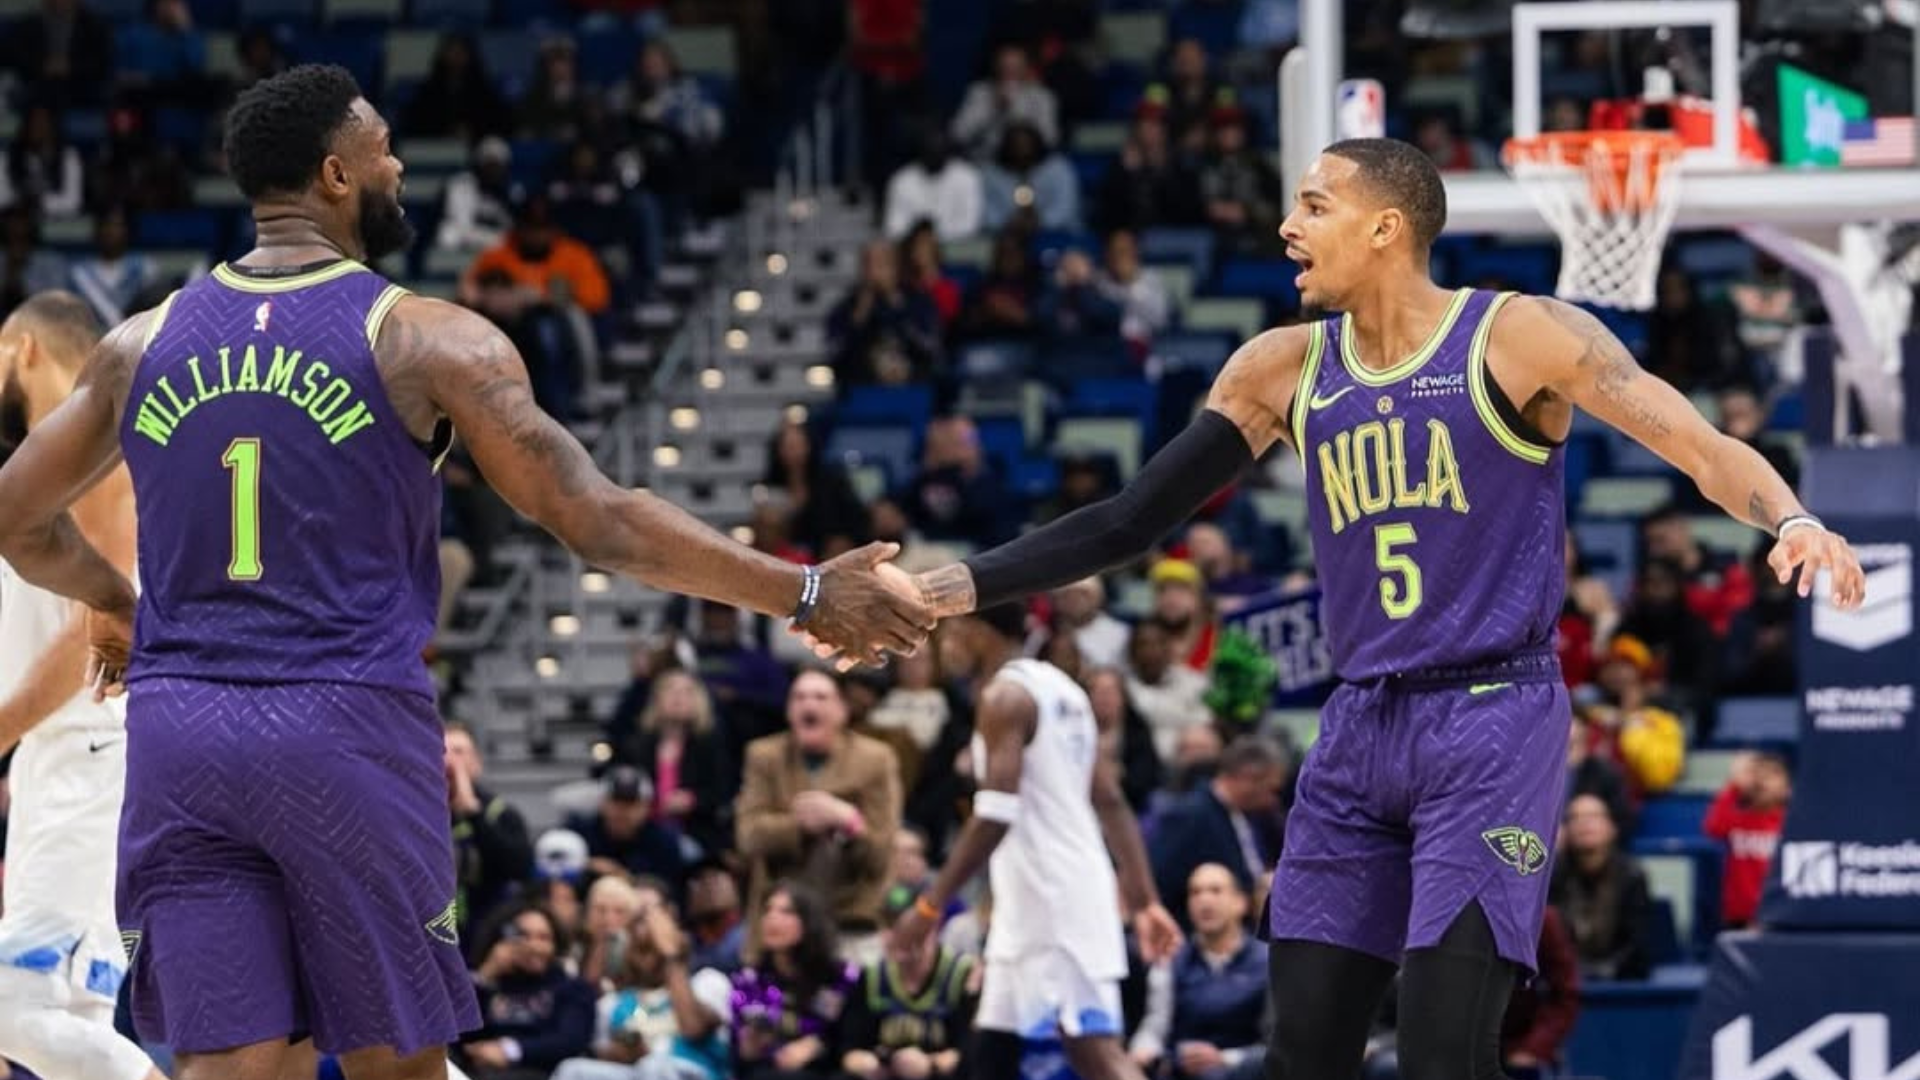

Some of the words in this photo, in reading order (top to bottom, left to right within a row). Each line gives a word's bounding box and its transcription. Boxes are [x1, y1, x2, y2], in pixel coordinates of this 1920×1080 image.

[134, 345, 375, 446] WILLIAMSON
[1411, 373, 1466, 389] NEWAGE
[221, 437, 264, 581] 1
[1318, 417, 1470, 532] NOLA
[1374, 522, 1422, 620] 5
